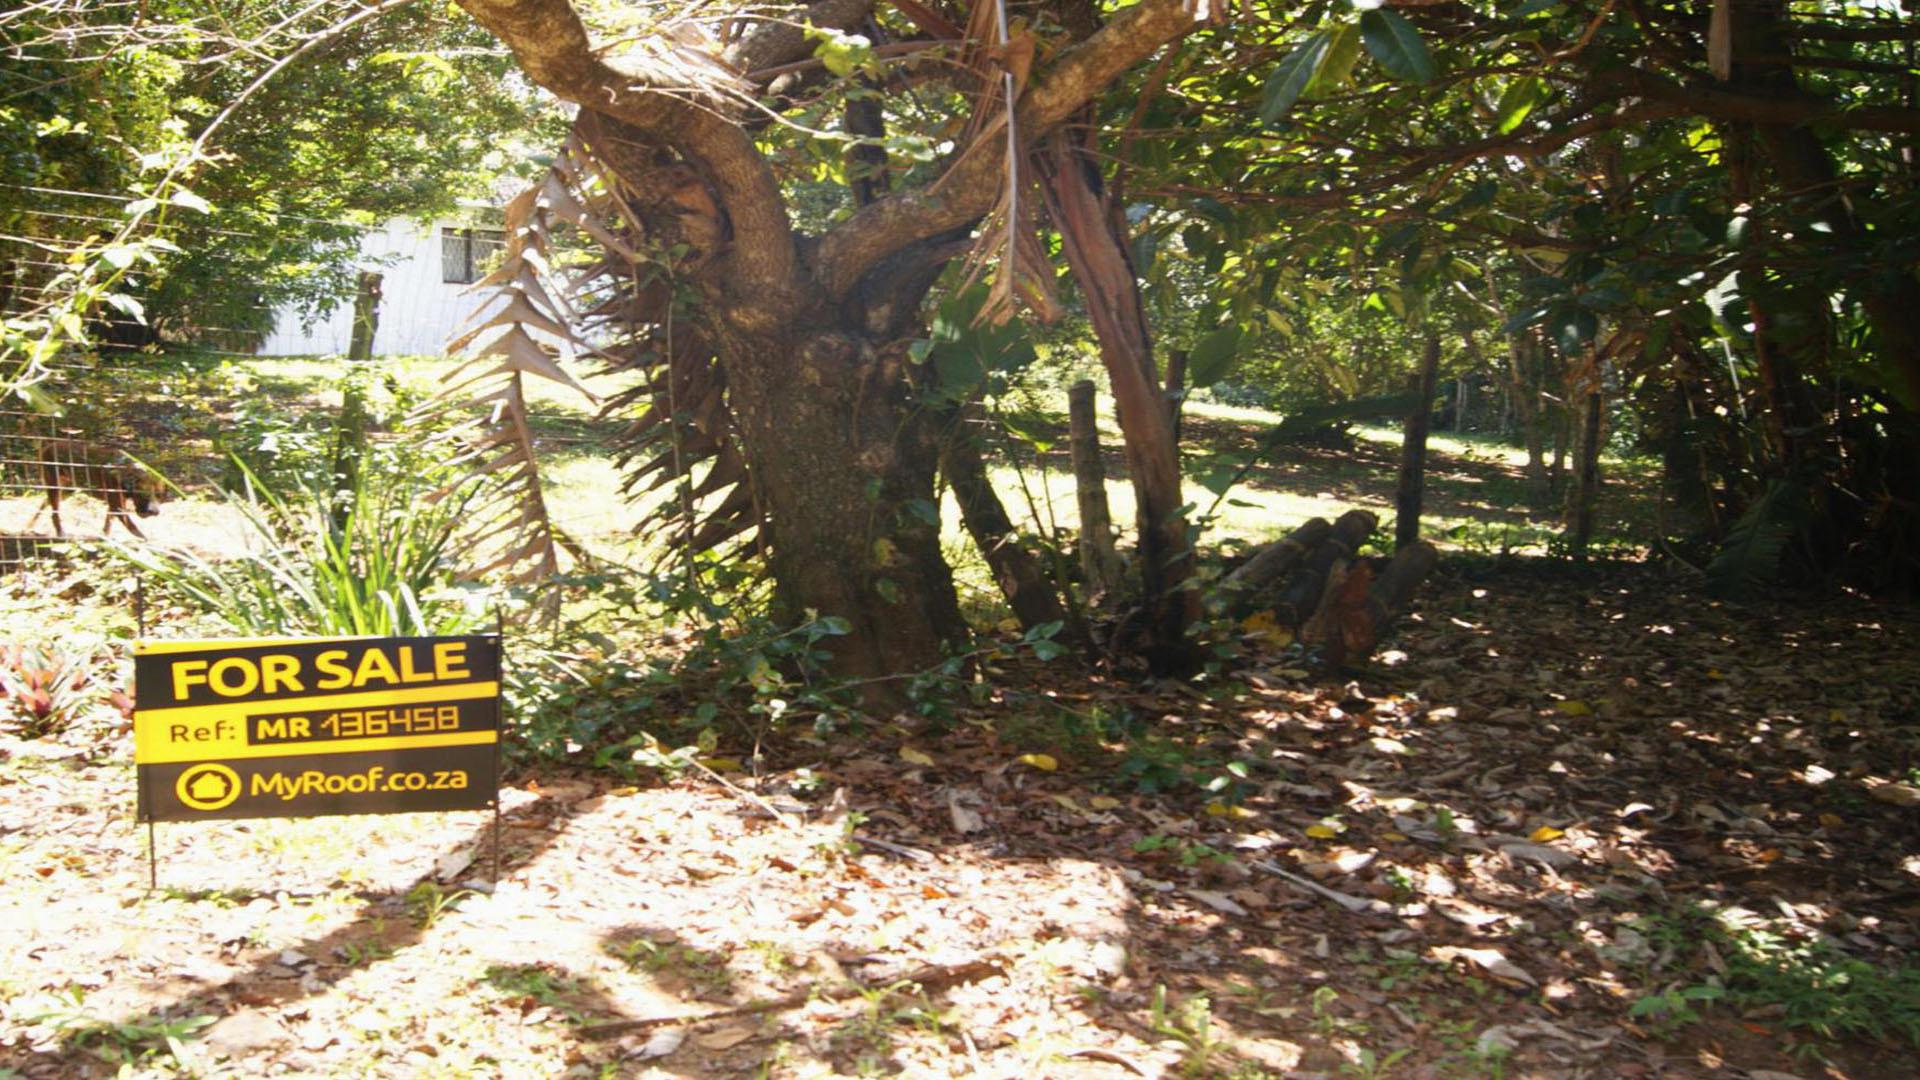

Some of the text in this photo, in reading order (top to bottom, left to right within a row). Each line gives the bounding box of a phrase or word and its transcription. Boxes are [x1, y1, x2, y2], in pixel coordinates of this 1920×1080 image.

[171, 642, 472, 701] FOR SALE
[170, 706, 460, 743] Ref: MR 136458
[251, 766, 468, 800] MyRoof.co.za
